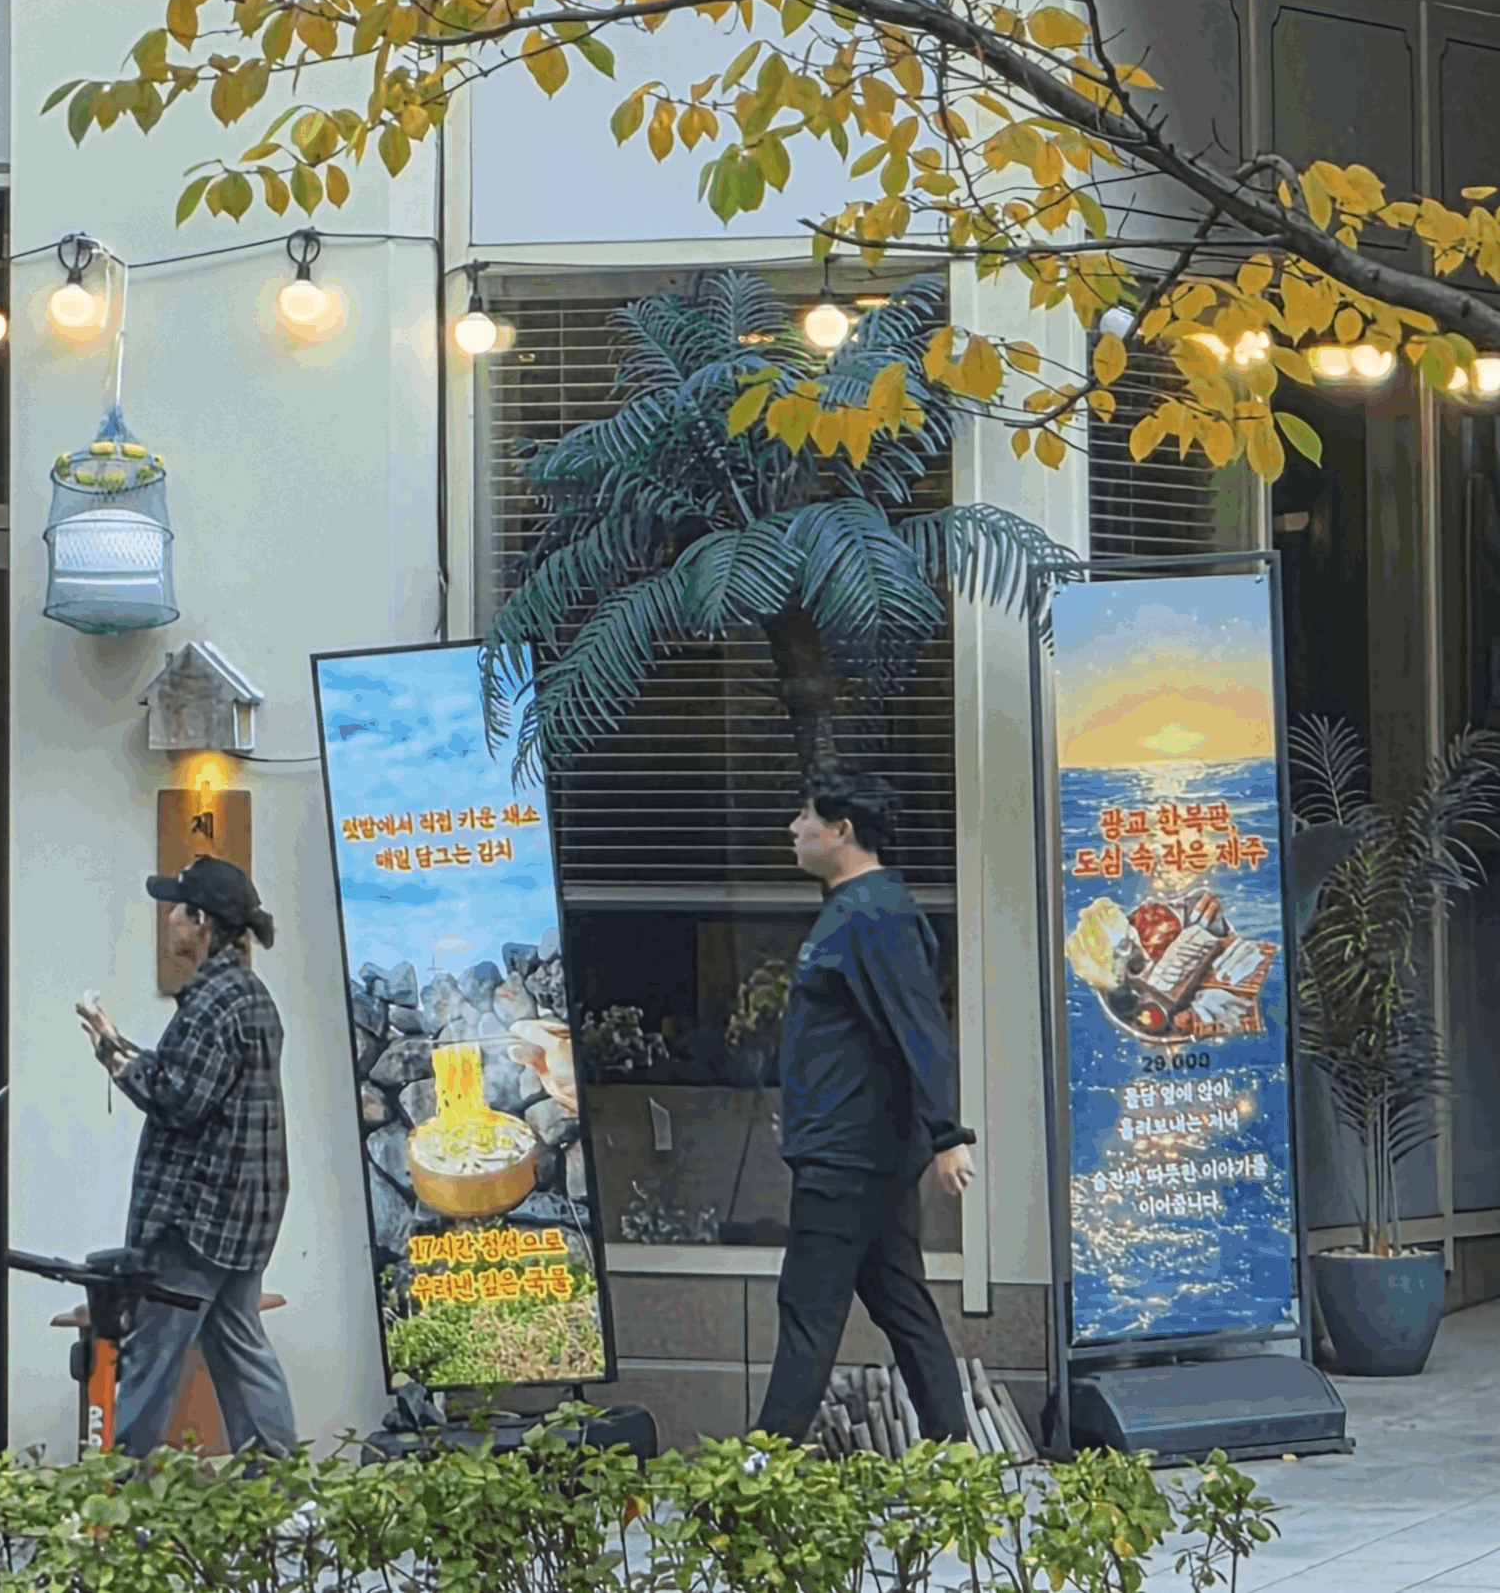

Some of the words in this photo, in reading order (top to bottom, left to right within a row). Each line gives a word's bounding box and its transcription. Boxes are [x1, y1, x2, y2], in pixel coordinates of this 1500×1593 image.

[342, 812, 414, 840] 텃밭에서
[418, 809, 453, 834] 직접
[457, 806, 496, 830] 키운
[501, 803, 541, 827] 채소
[1100, 807, 1150, 841] 광교
[375, 846, 411, 871] 매일
[415, 843, 472, 869] 담그는
[477, 838, 512, 863] 김치
[1073, 843, 1122, 877] 도심
[1129, 842, 1153, 875] 속
[1163, 838, 1210, 872] 작은
[1216, 834, 1268, 872] 제주
[1197, 1078, 1231, 1102] 앉아
[1208, 1108, 1239, 1132] 저녁
[1146, 1161, 1199, 1187] 따뜻한
[1202, 1154, 1267, 1181] 이야기를
[411, 1233, 476, 1265] 17시간
[479, 1230, 566, 1261] 정성으로
[413, 1271, 476, 1305] 우려낸
[480, 1269, 520, 1298] 깊은
[523, 1266, 572, 1299] 국물
